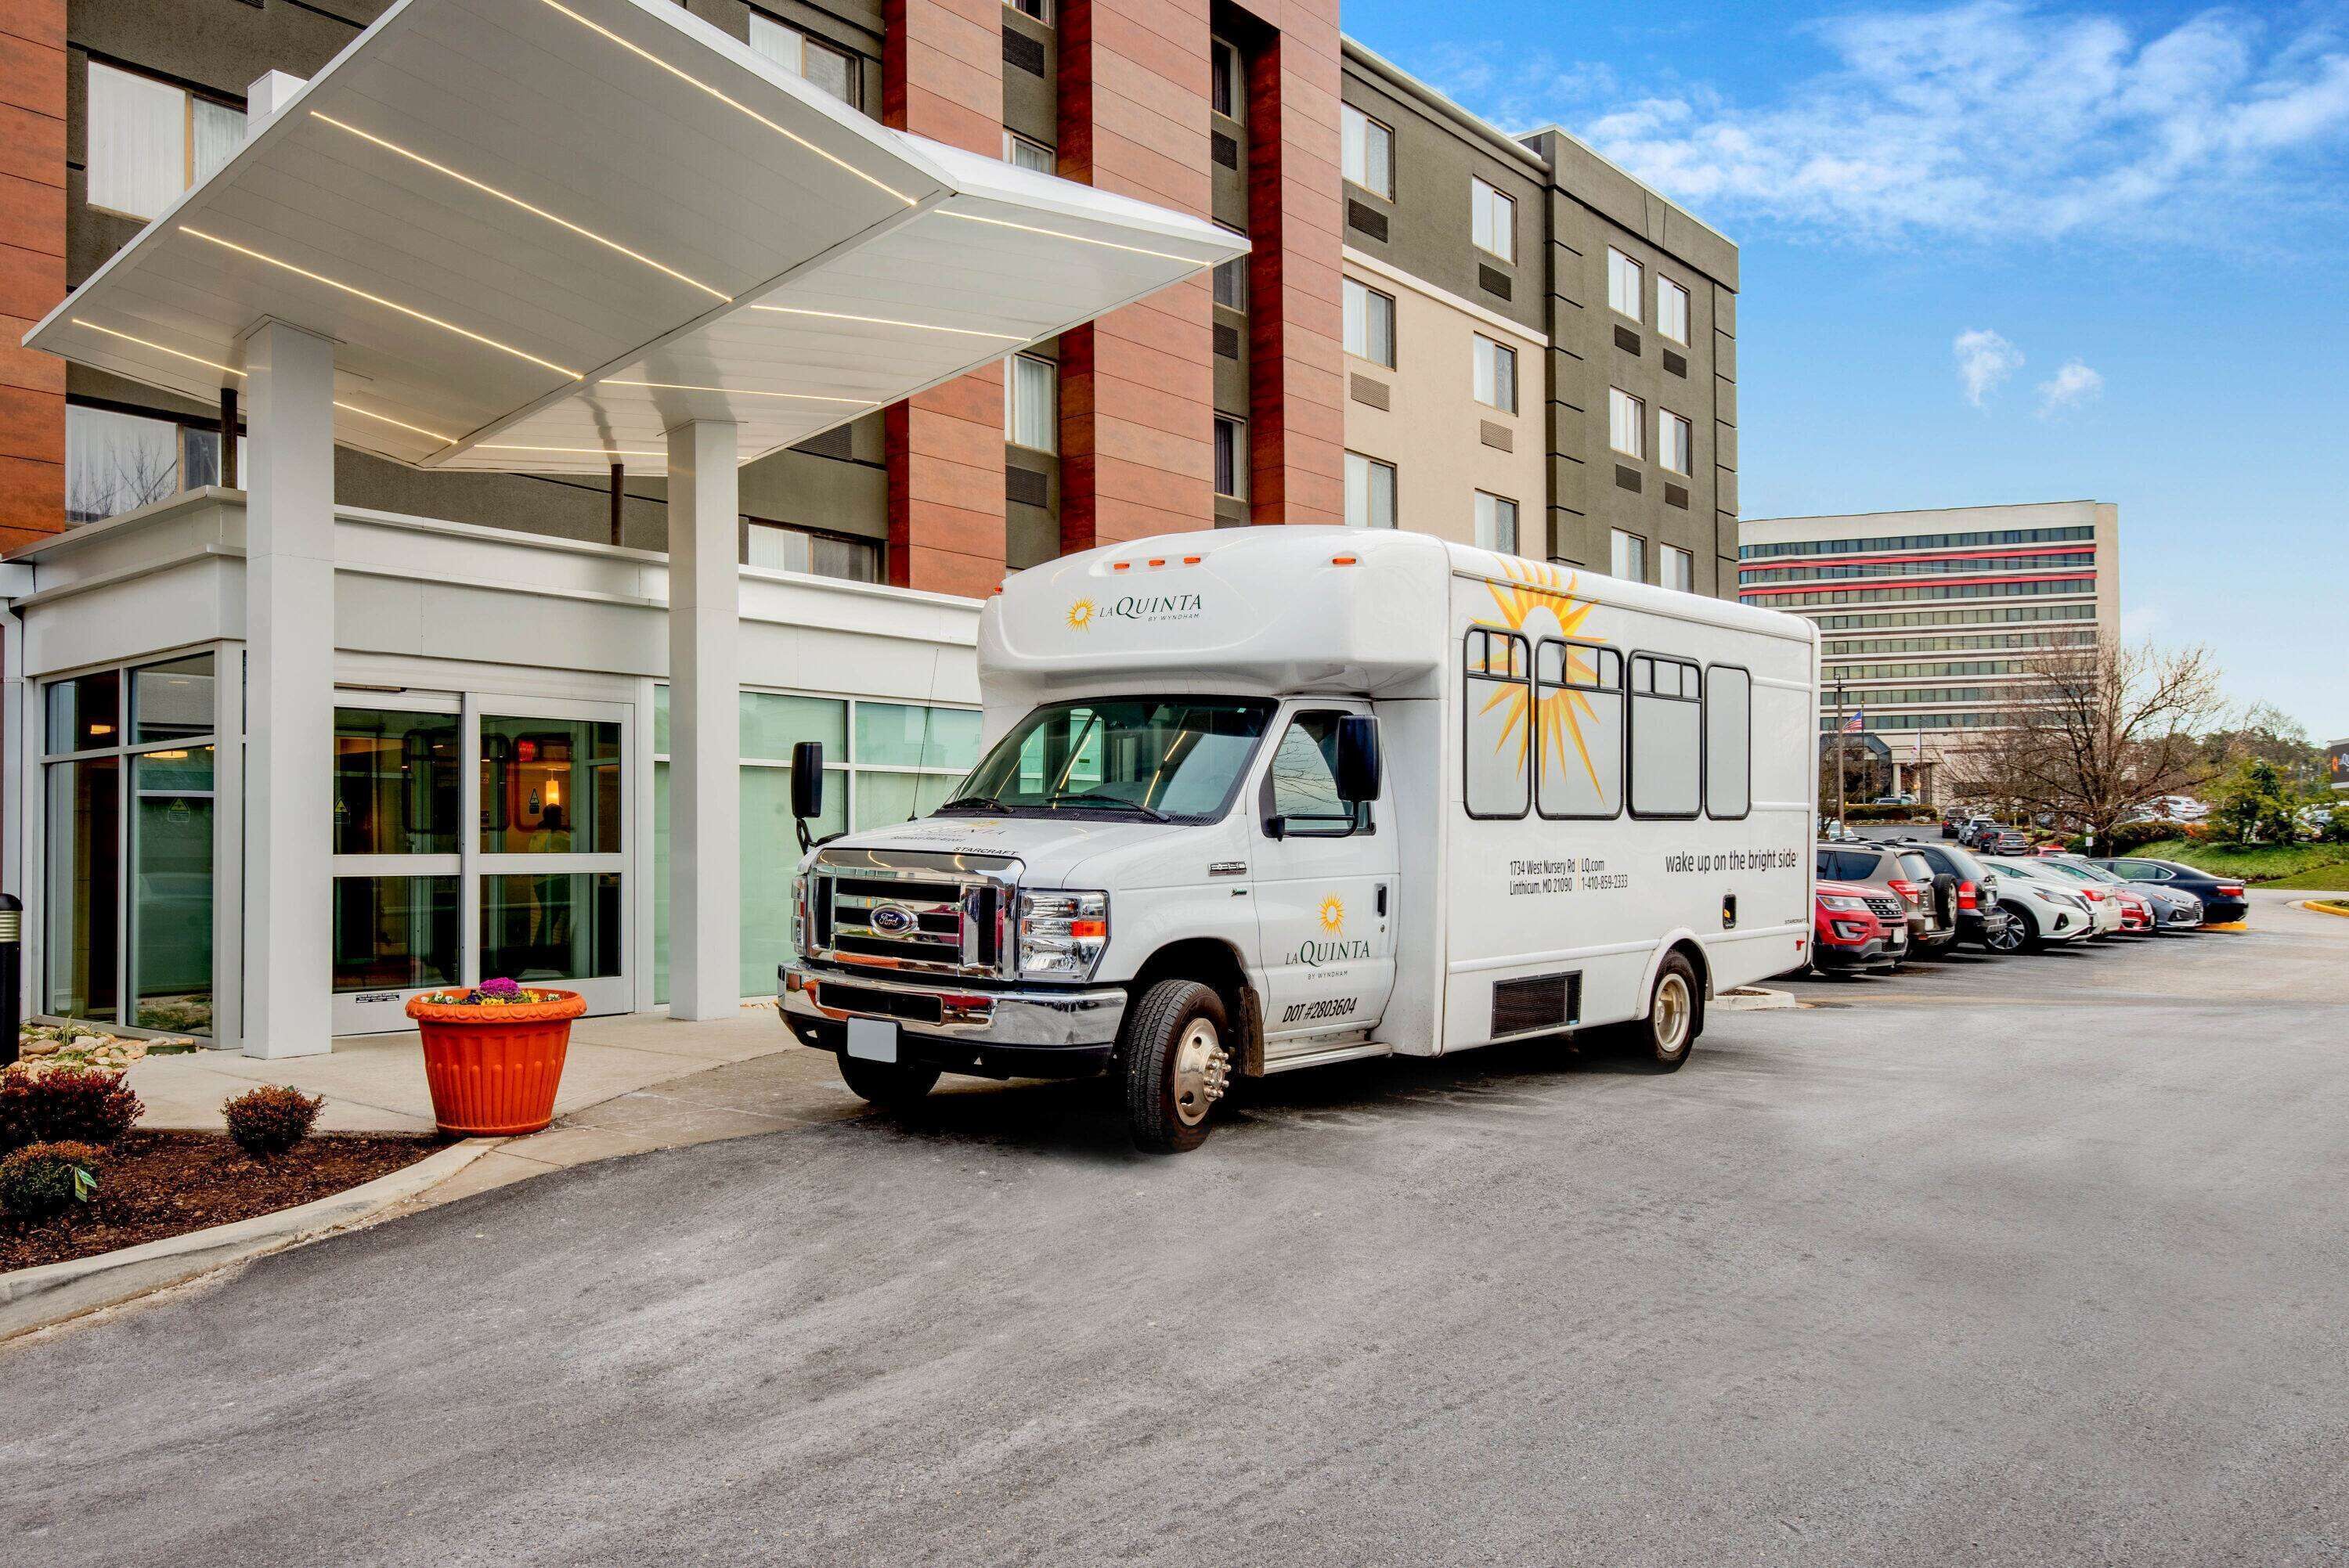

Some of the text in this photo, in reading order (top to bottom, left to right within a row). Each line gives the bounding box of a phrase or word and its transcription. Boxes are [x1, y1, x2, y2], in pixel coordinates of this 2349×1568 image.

[1099, 593, 1202, 619] LA QUINTA
[953, 846, 1019, 856] STARCRAFT
[1510, 859, 1575, 875] 1734 West Nursery Rd
[1582, 858, 1604, 873] LQ.com
[1665, 849, 1796, 874] wake up on the bright side
[1510, 878, 1572, 896] Linthicum, MD 21090
[1582, 874, 1628, 891] 1-410-859-2333
[879, 912, 899, 926] Ford
[1285, 940, 1370, 968] LA QUINTA
[1317, 971, 1348, 979] WYNDHAM
[1282, 997, 1358, 1023] DOT #2803604
